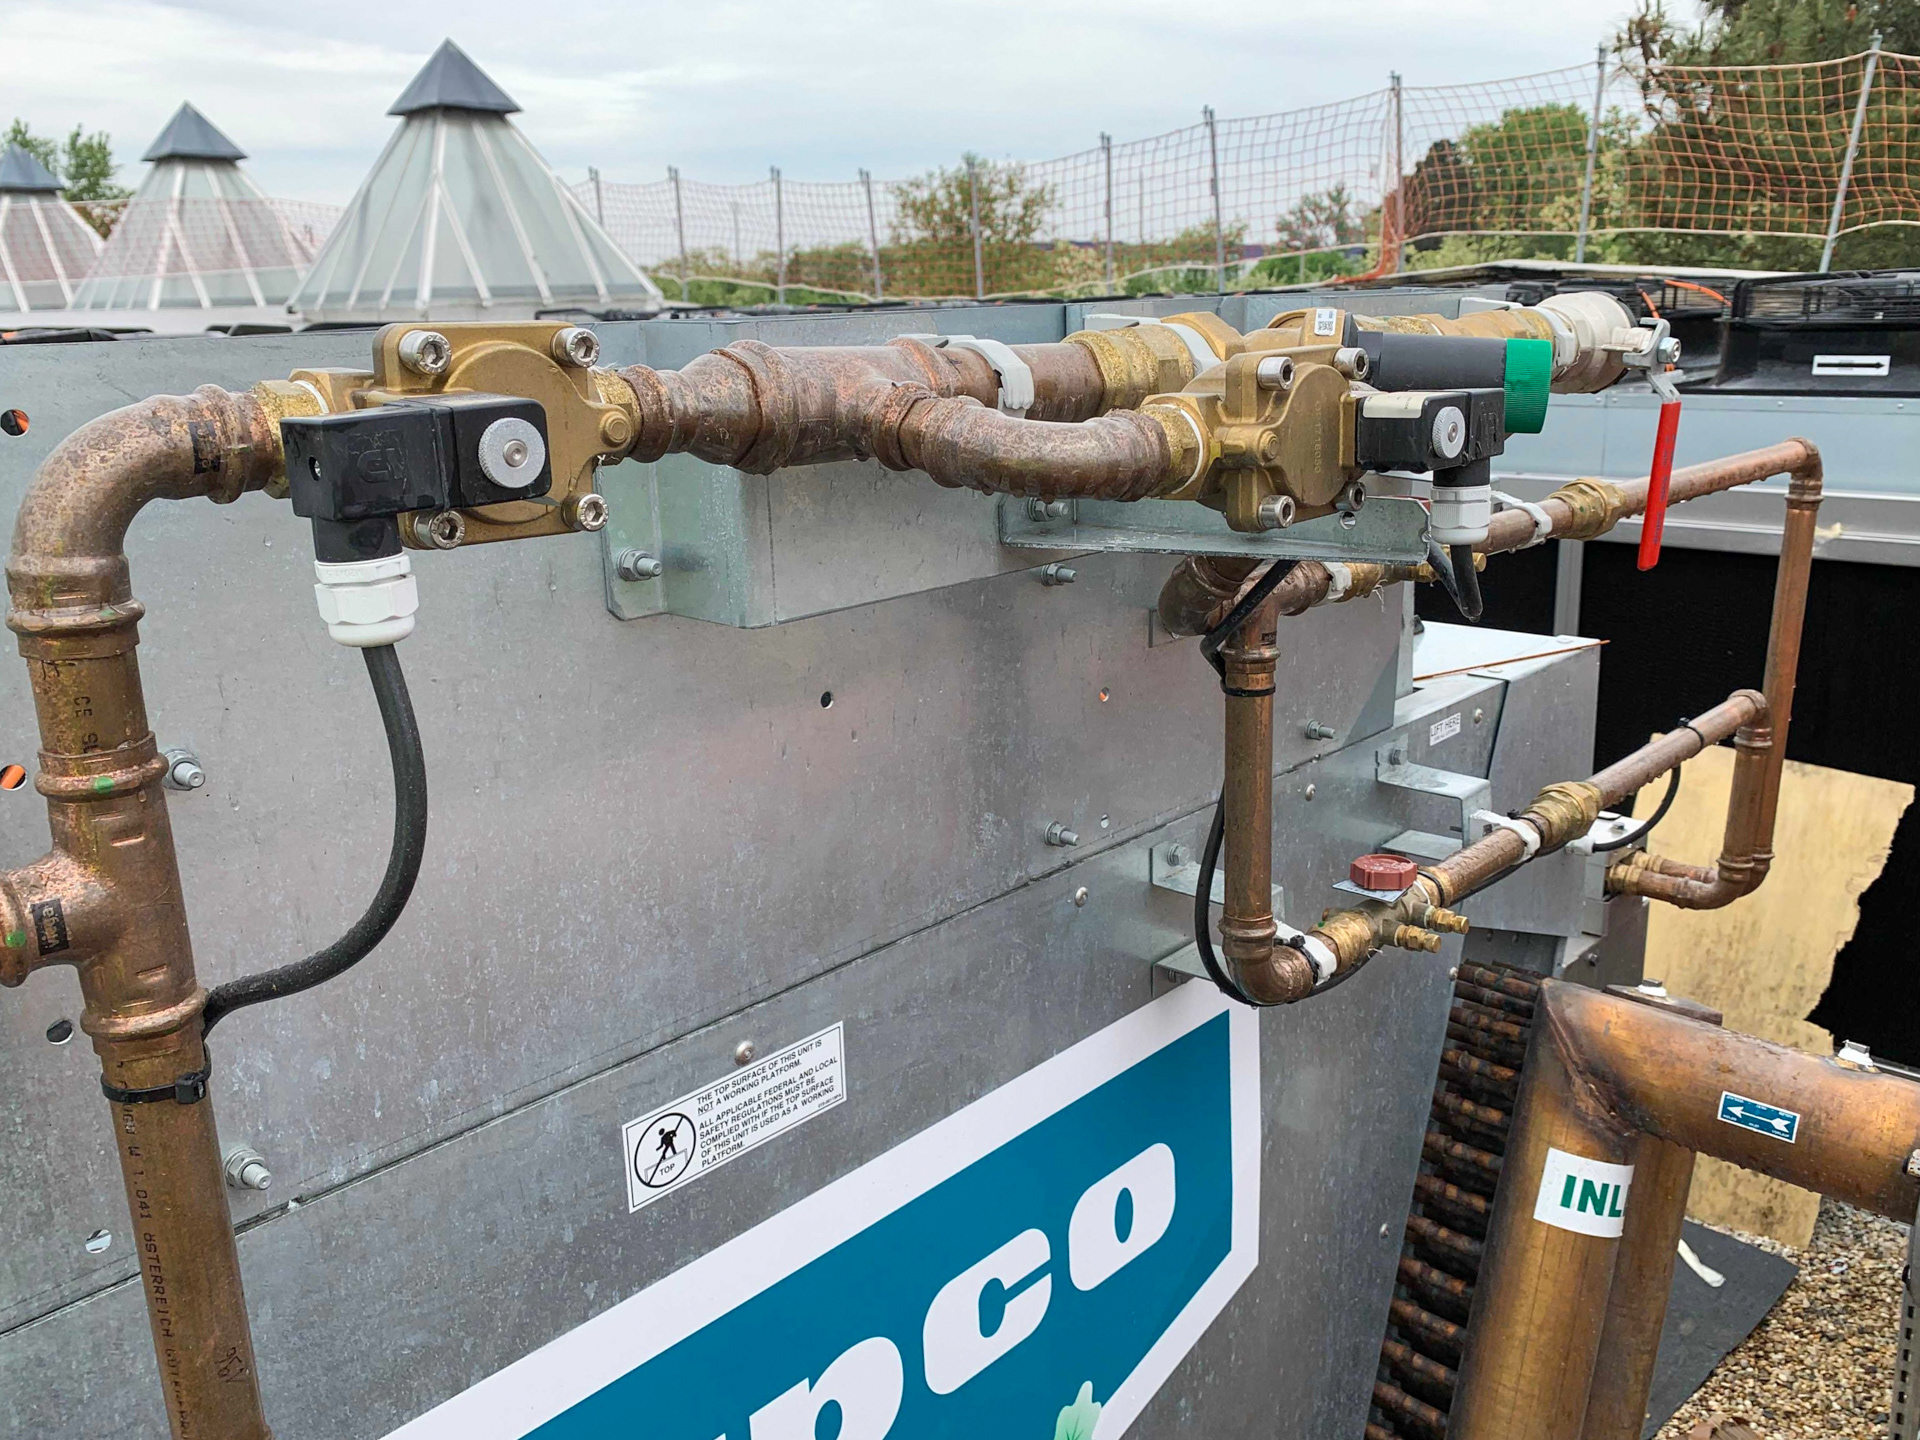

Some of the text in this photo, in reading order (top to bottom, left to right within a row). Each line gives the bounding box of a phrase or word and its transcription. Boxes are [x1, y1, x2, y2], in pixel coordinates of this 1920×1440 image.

[1430, 722, 1443, 737] LIFT
[1445, 714, 1460, 729] HERE
[697, 1039, 822, 1105] THE TOP SURFACE OF THIS UNIT IS
[697, 1059, 802, 1115] NOT A WORKING PLATFORM.
[699, 1056, 838, 1131] ALL APPLICABLE FEDERAL AND LOCAL
[699, 1076, 816, 1140] SAFETY REGULATIONS MUST BE
[700, 1075, 834, 1149] COMPLIED WITH IF THE TOP SURFACE
[701, 1148, 712, 1158] OF
[714, 1138, 731, 1153] THIS
[732, 1127, 749, 1143] UNIT
[750, 1123, 759, 1133] IS
[760, 1112, 780, 1128] USED
[781, 1106, 791, 1117] AS
[792, 1103, 798, 1111] A
[801, 1084, 835, 1107] WORKING
[659, 1163, 676, 1176] TOP
[702, 1140, 745, 1168] PLATFORM.
[134, 1170, 153, 1219] 1.041
[1560, 1174, 1627, 1218] INL
[713, 1142, 1176, 1440] pco
